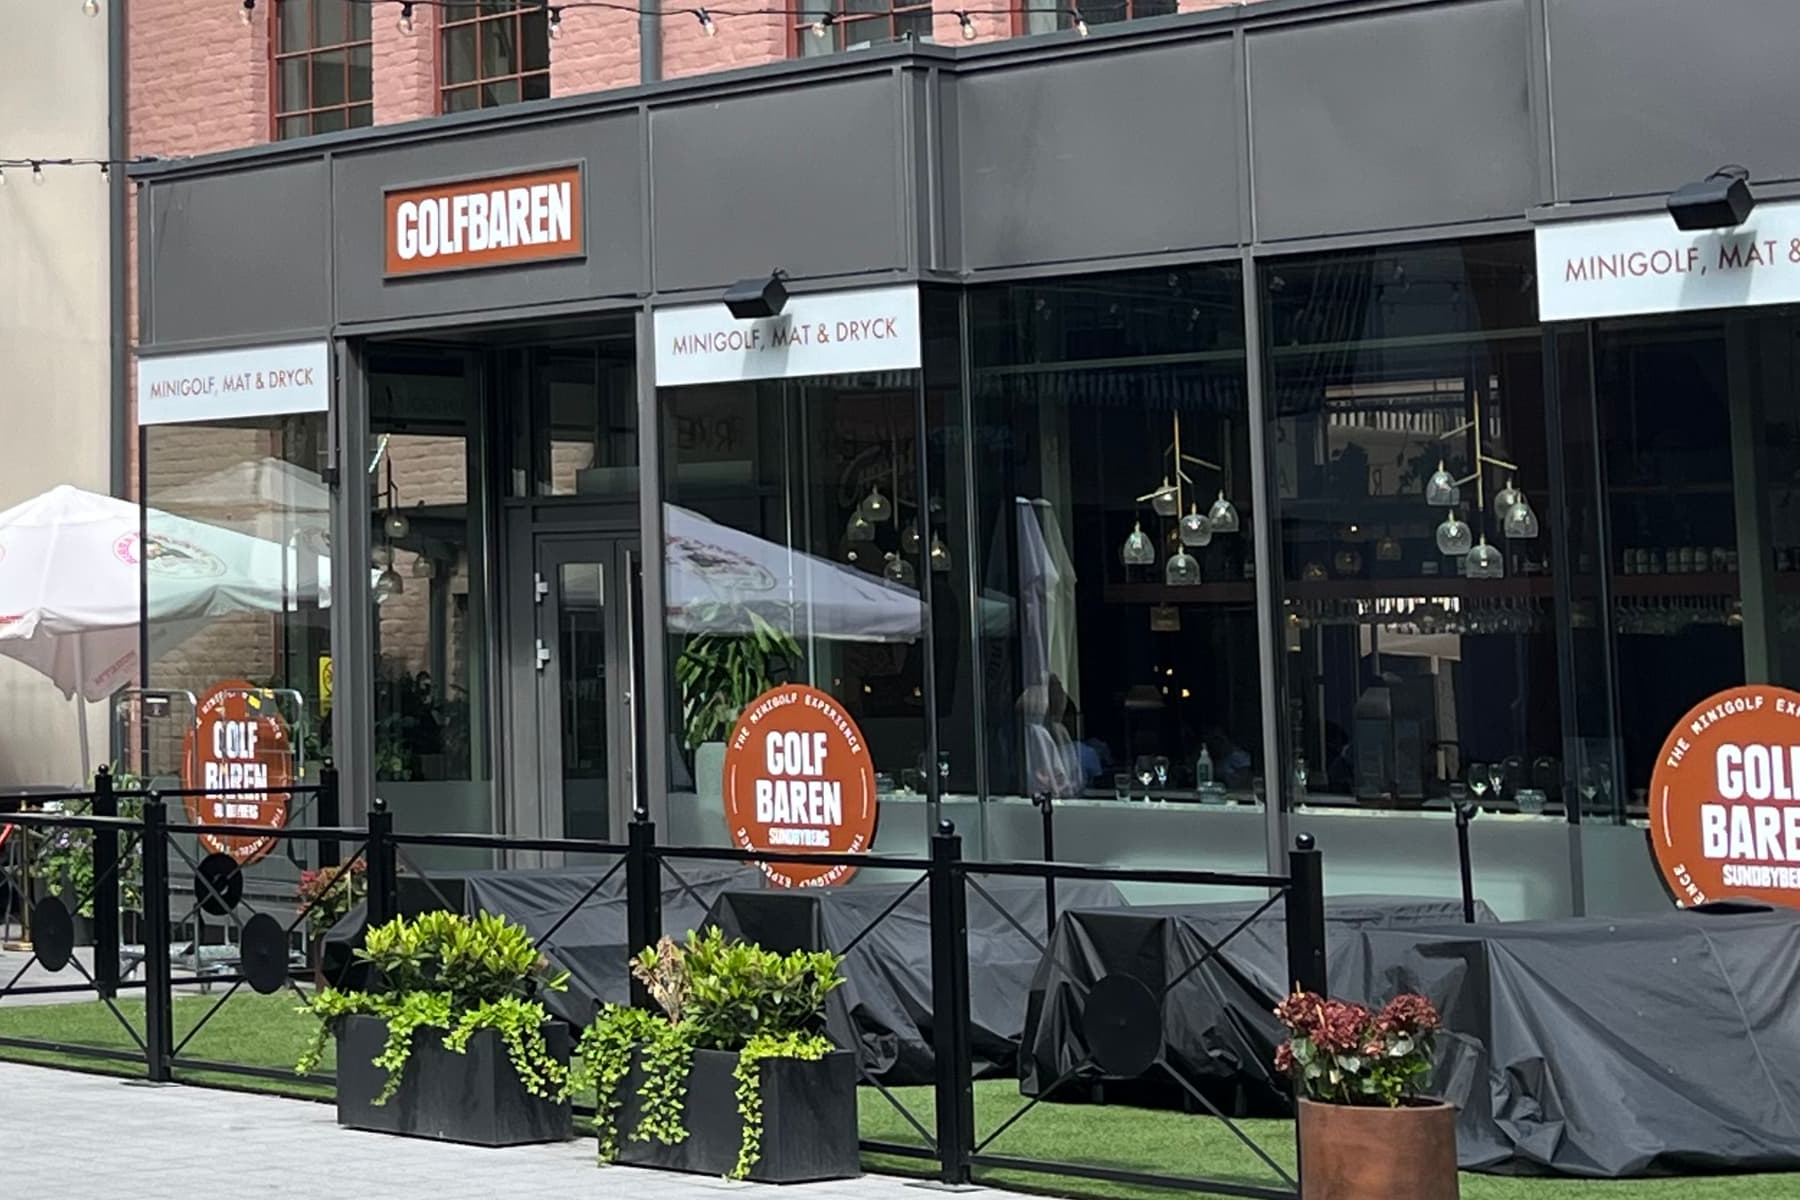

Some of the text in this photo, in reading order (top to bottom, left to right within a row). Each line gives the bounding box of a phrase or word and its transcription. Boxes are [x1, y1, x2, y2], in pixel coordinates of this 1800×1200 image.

[397, 181, 572, 260] GOLFBAREN
[1565, 246, 1707, 283] MINIGOLF,
[1718, 240, 1777, 270] MAT
[672, 317, 898, 356] MINIGOLF, MAT & DRYCK
[150, 367, 314, 399] MINIGOLF, MAT & DRYCK
[733, 691, 862, 755] THE MINIGOLF EXPERIENCE
[1666, 736, 1691, 769] THE
[1690, 695, 1765, 736] MINIGOLF
[765, 730, 828, 777] GOLF
[755, 779, 843, 826] BAREN
